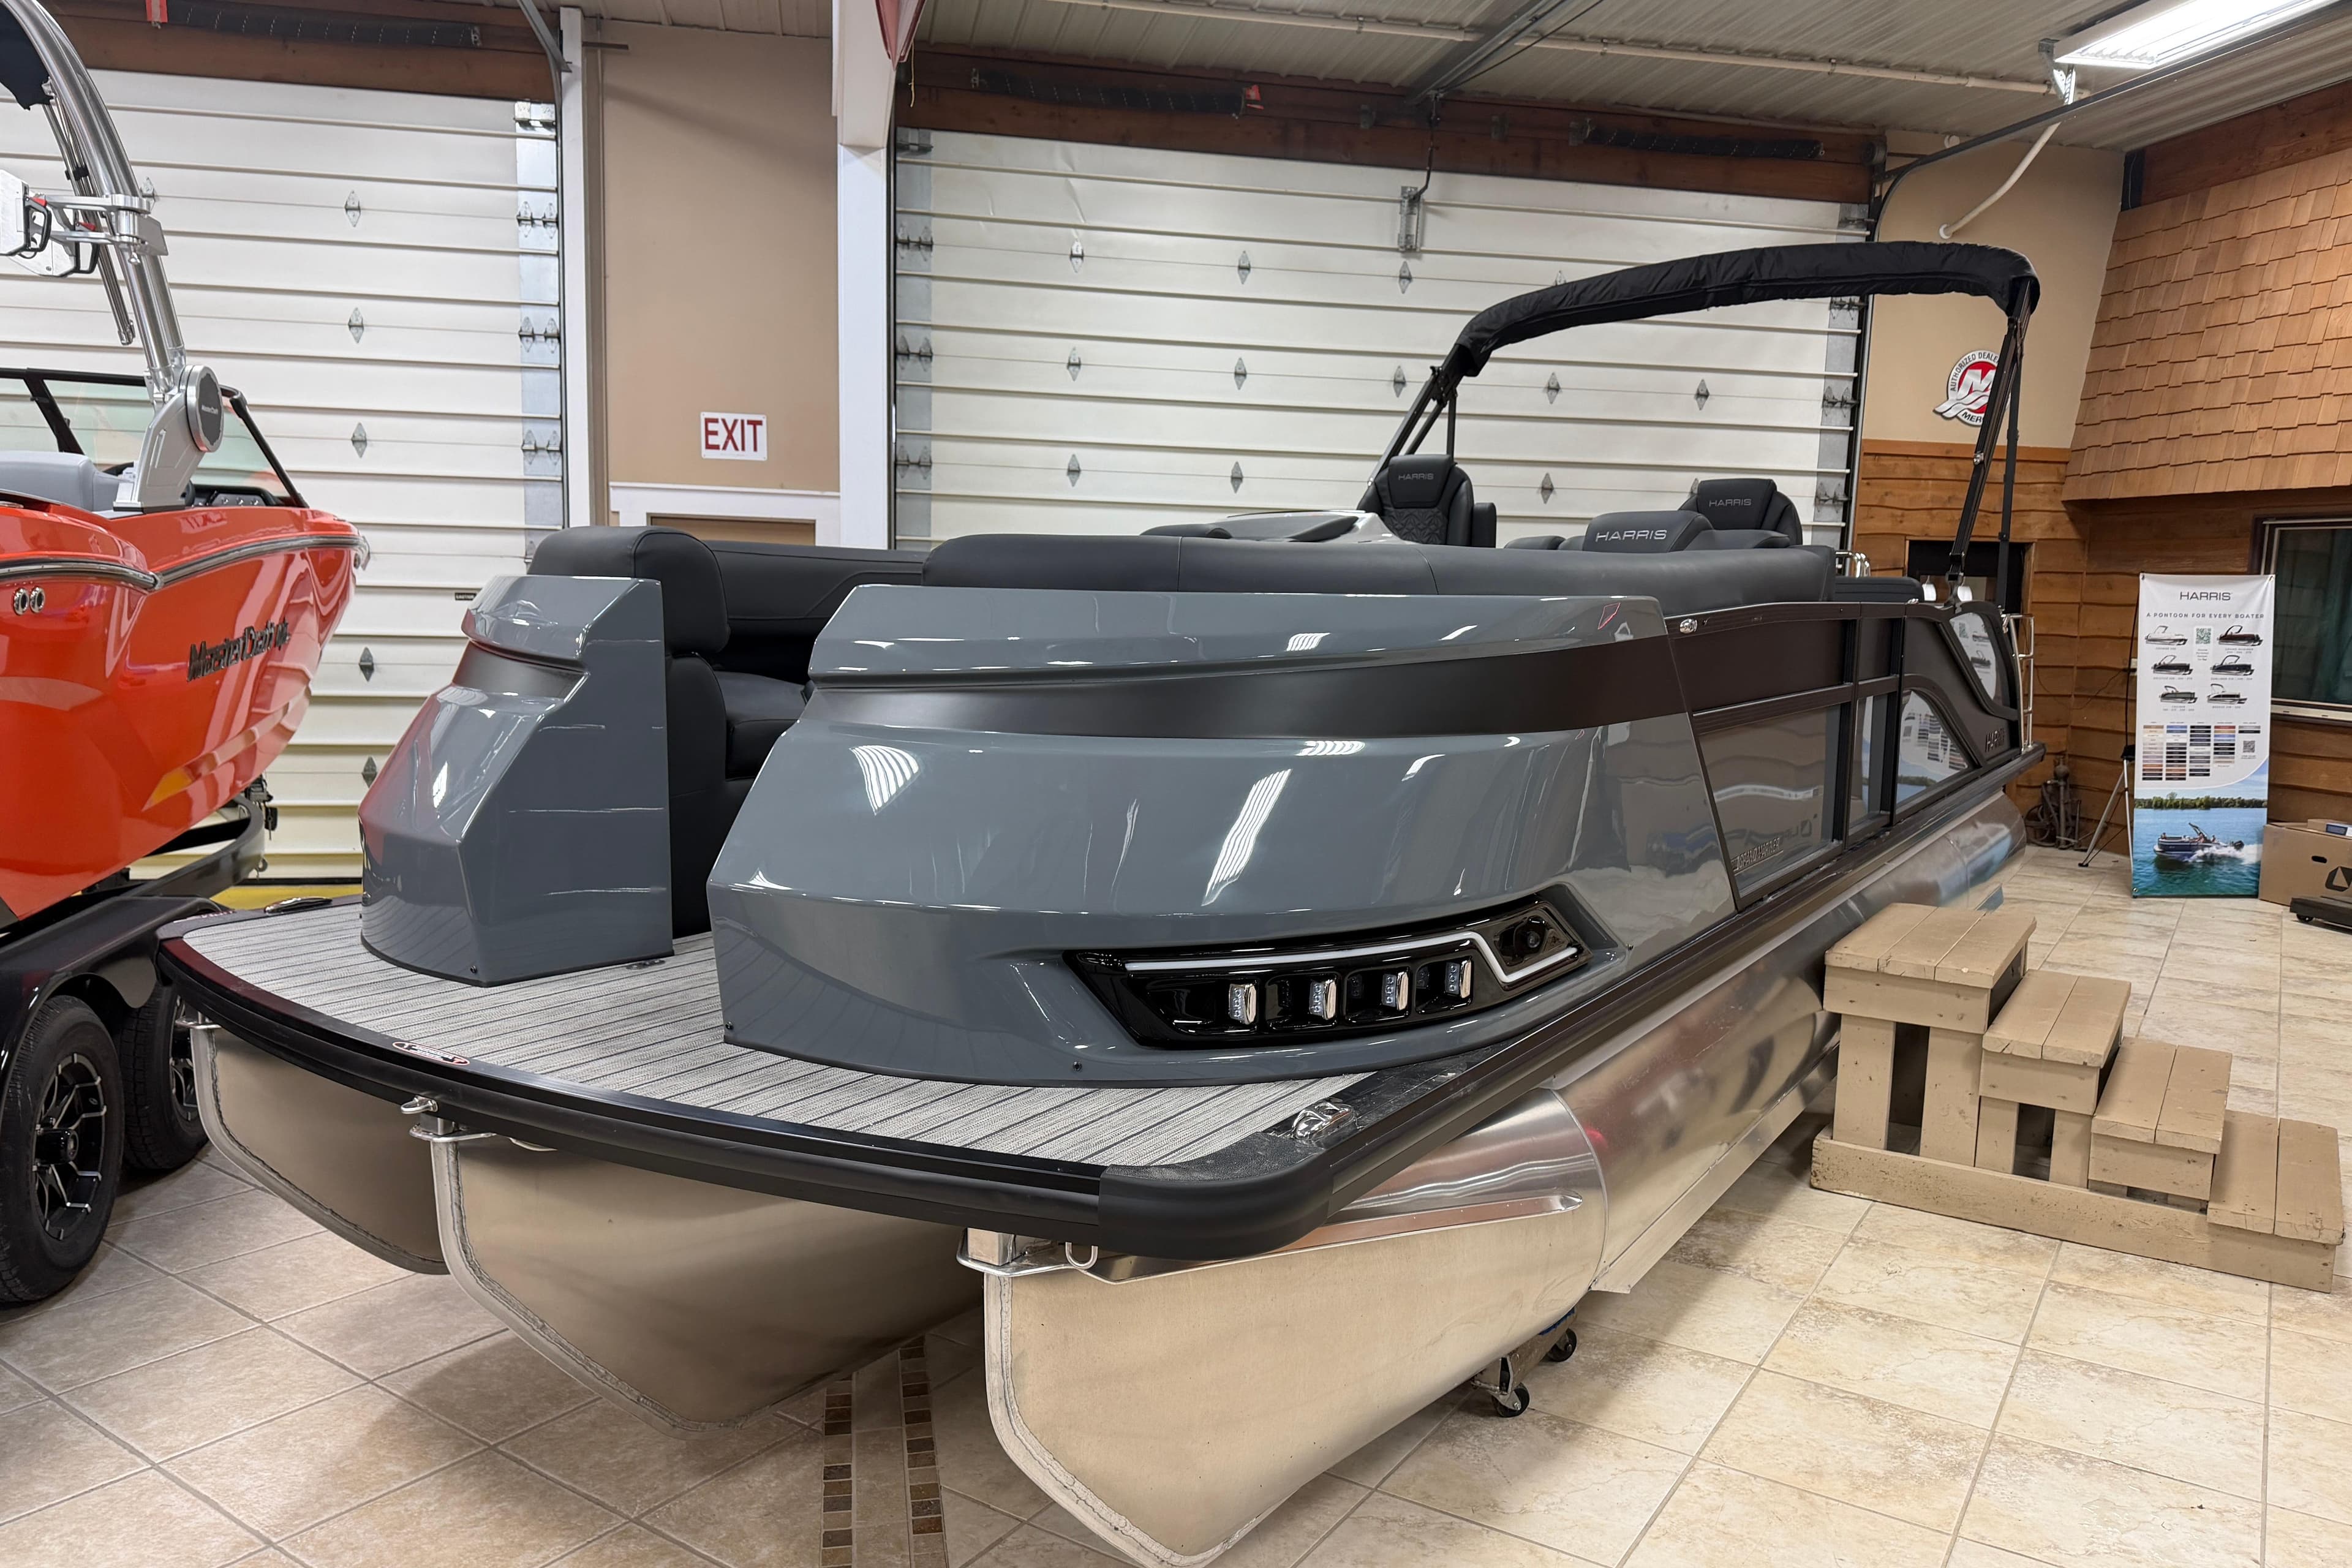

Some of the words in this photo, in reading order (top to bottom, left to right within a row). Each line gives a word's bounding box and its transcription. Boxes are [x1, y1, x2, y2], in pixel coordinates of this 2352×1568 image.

[1950, 353, 1976, 391] AUTHORIZED
[1962, 411, 1983, 422] MER
[704, 418, 763, 452] EXIT
[1709, 499, 1752, 508] HARRIS
[1596, 530, 1667, 542] HARRIS
[2180, 592, 2231, 601] HARRIS
[187, 620, 275, 682] MasterCraft
